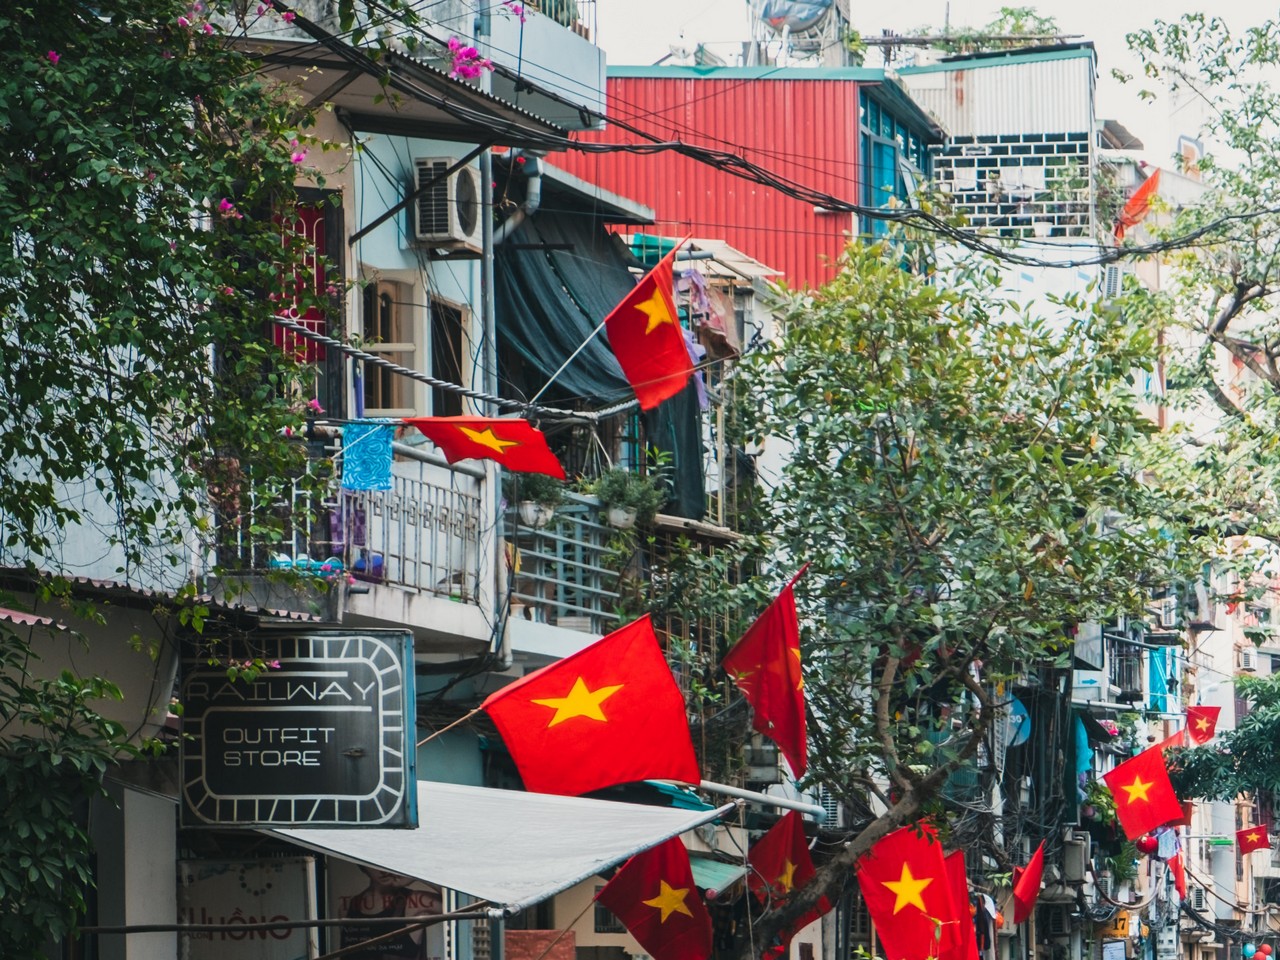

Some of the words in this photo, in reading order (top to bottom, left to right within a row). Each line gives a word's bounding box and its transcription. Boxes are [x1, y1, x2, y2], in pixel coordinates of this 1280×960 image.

[186, 681, 376, 701] RAILWAY
[223, 727, 336, 744] OUTFIT
[223, 750, 321, 767] STORE
[1112, 917, 1127, 931] 17
